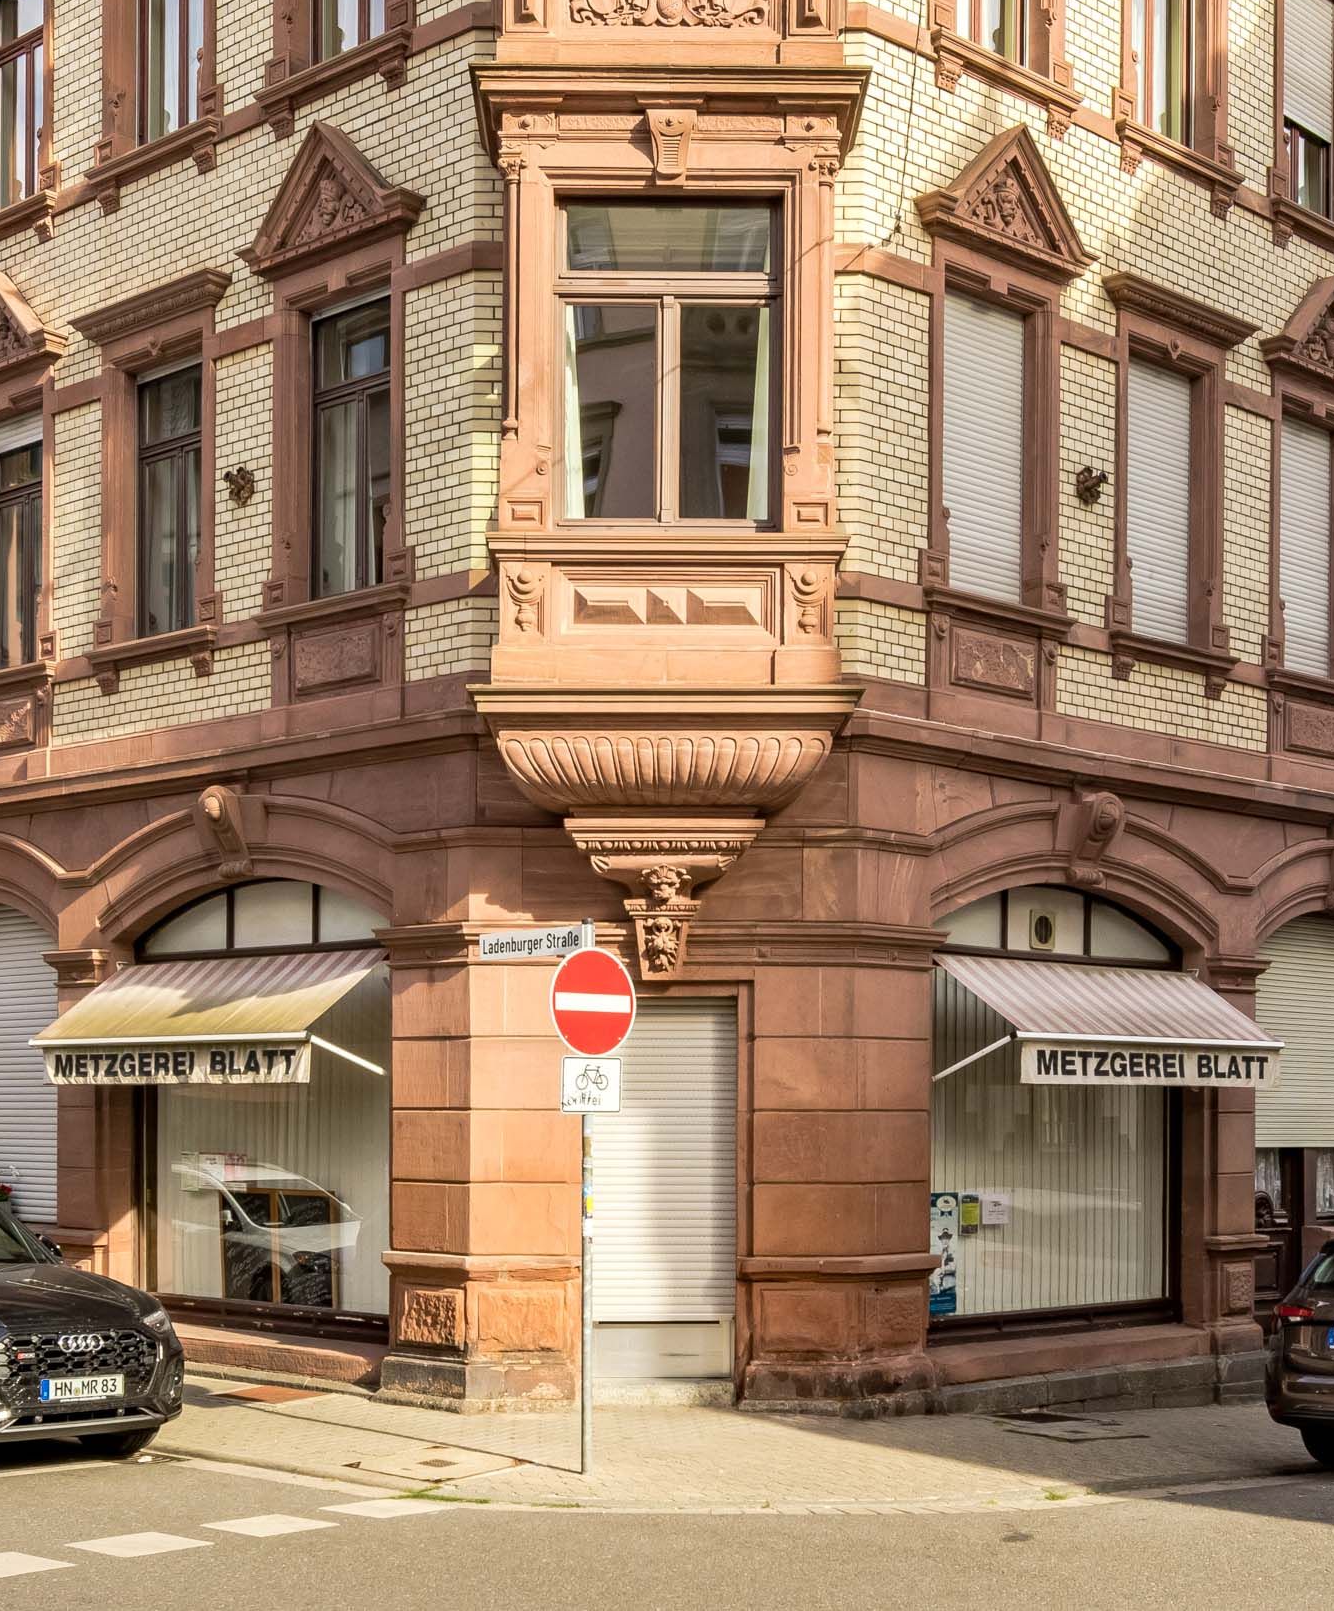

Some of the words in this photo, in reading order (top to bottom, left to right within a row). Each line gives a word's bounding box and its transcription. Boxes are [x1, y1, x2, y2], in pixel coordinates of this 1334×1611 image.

[482, 936, 544, 955] Ladenburger
[546, 931, 579, 949] Straße
[54, 1051, 195, 1078] METZGEREI
[209, 1049, 297, 1076] BLATT
[1036, 1049, 1185, 1078] METZGEREI
[1197, 1054, 1269, 1080] BLATT
[54, 1380, 73, 1397] HN
[81, 1379, 98, 1395] MR
[101, 1378, 117, 1393] 83
